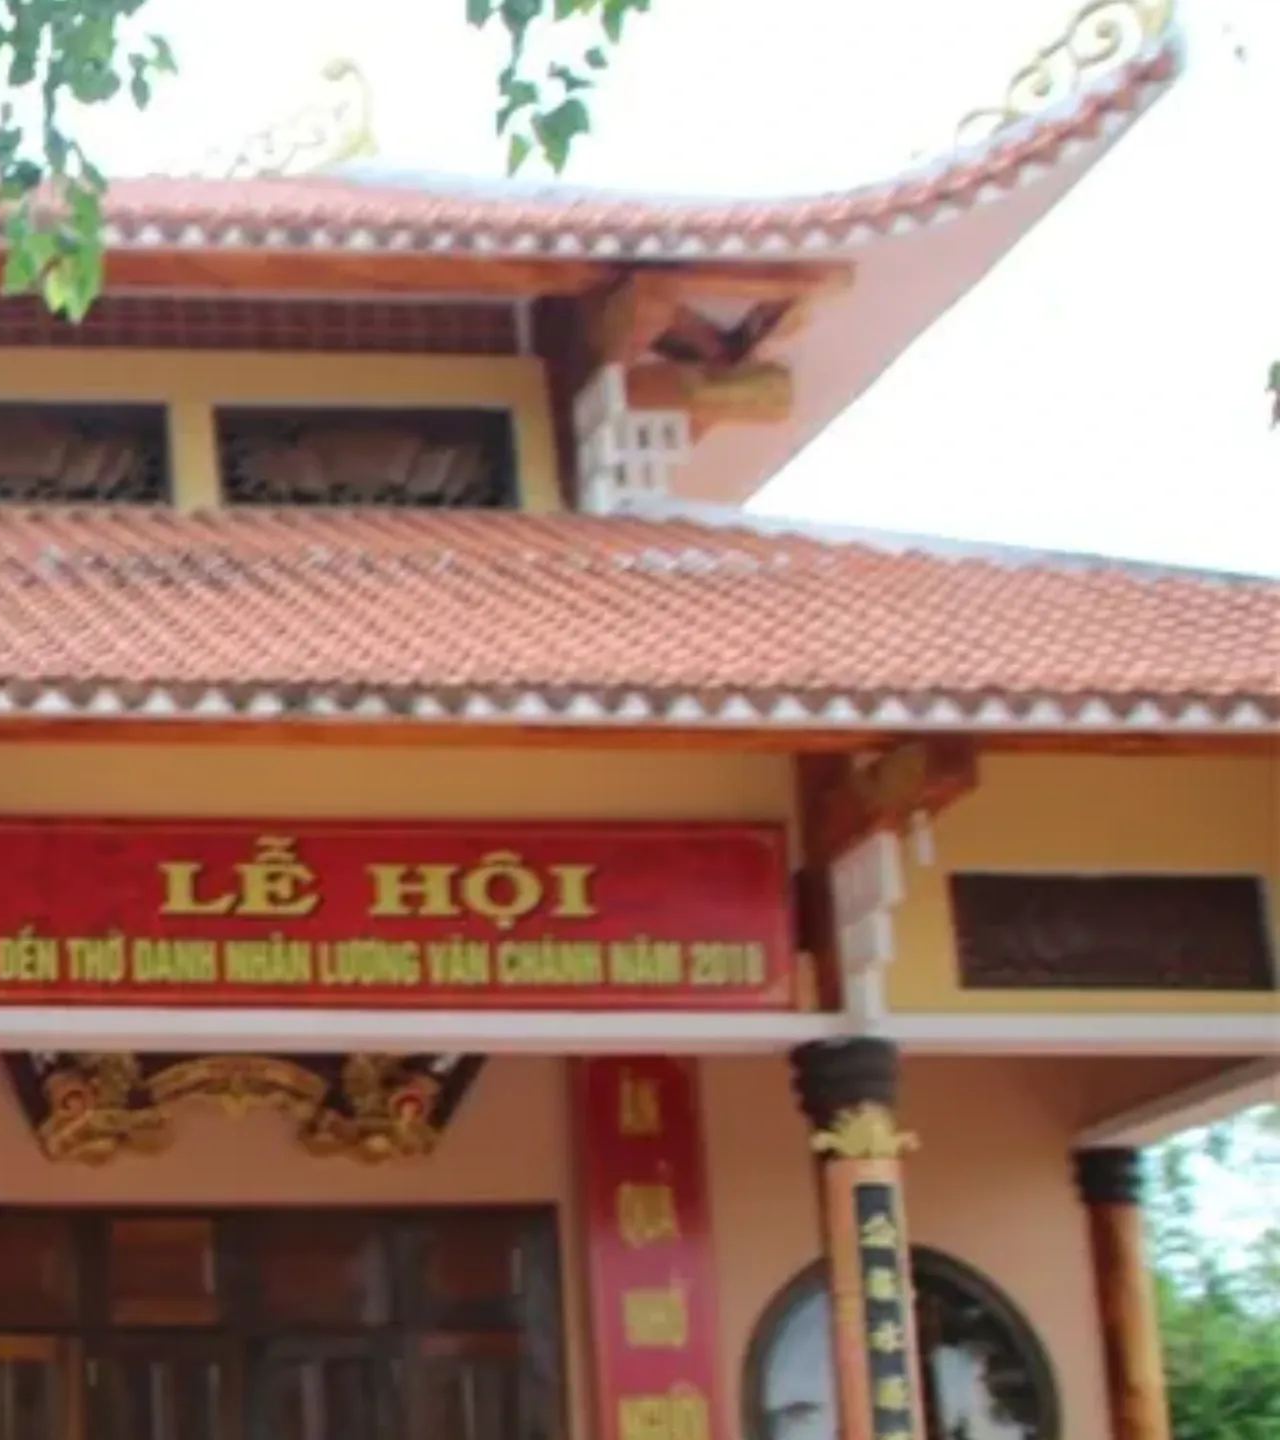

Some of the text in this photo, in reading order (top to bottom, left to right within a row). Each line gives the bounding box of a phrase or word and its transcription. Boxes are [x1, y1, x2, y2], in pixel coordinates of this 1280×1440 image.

[159, 835, 598, 929] LỄ HỘI
[428, 935, 489, 984] VĂN
[498, 933, 602, 984] CHÁNH
